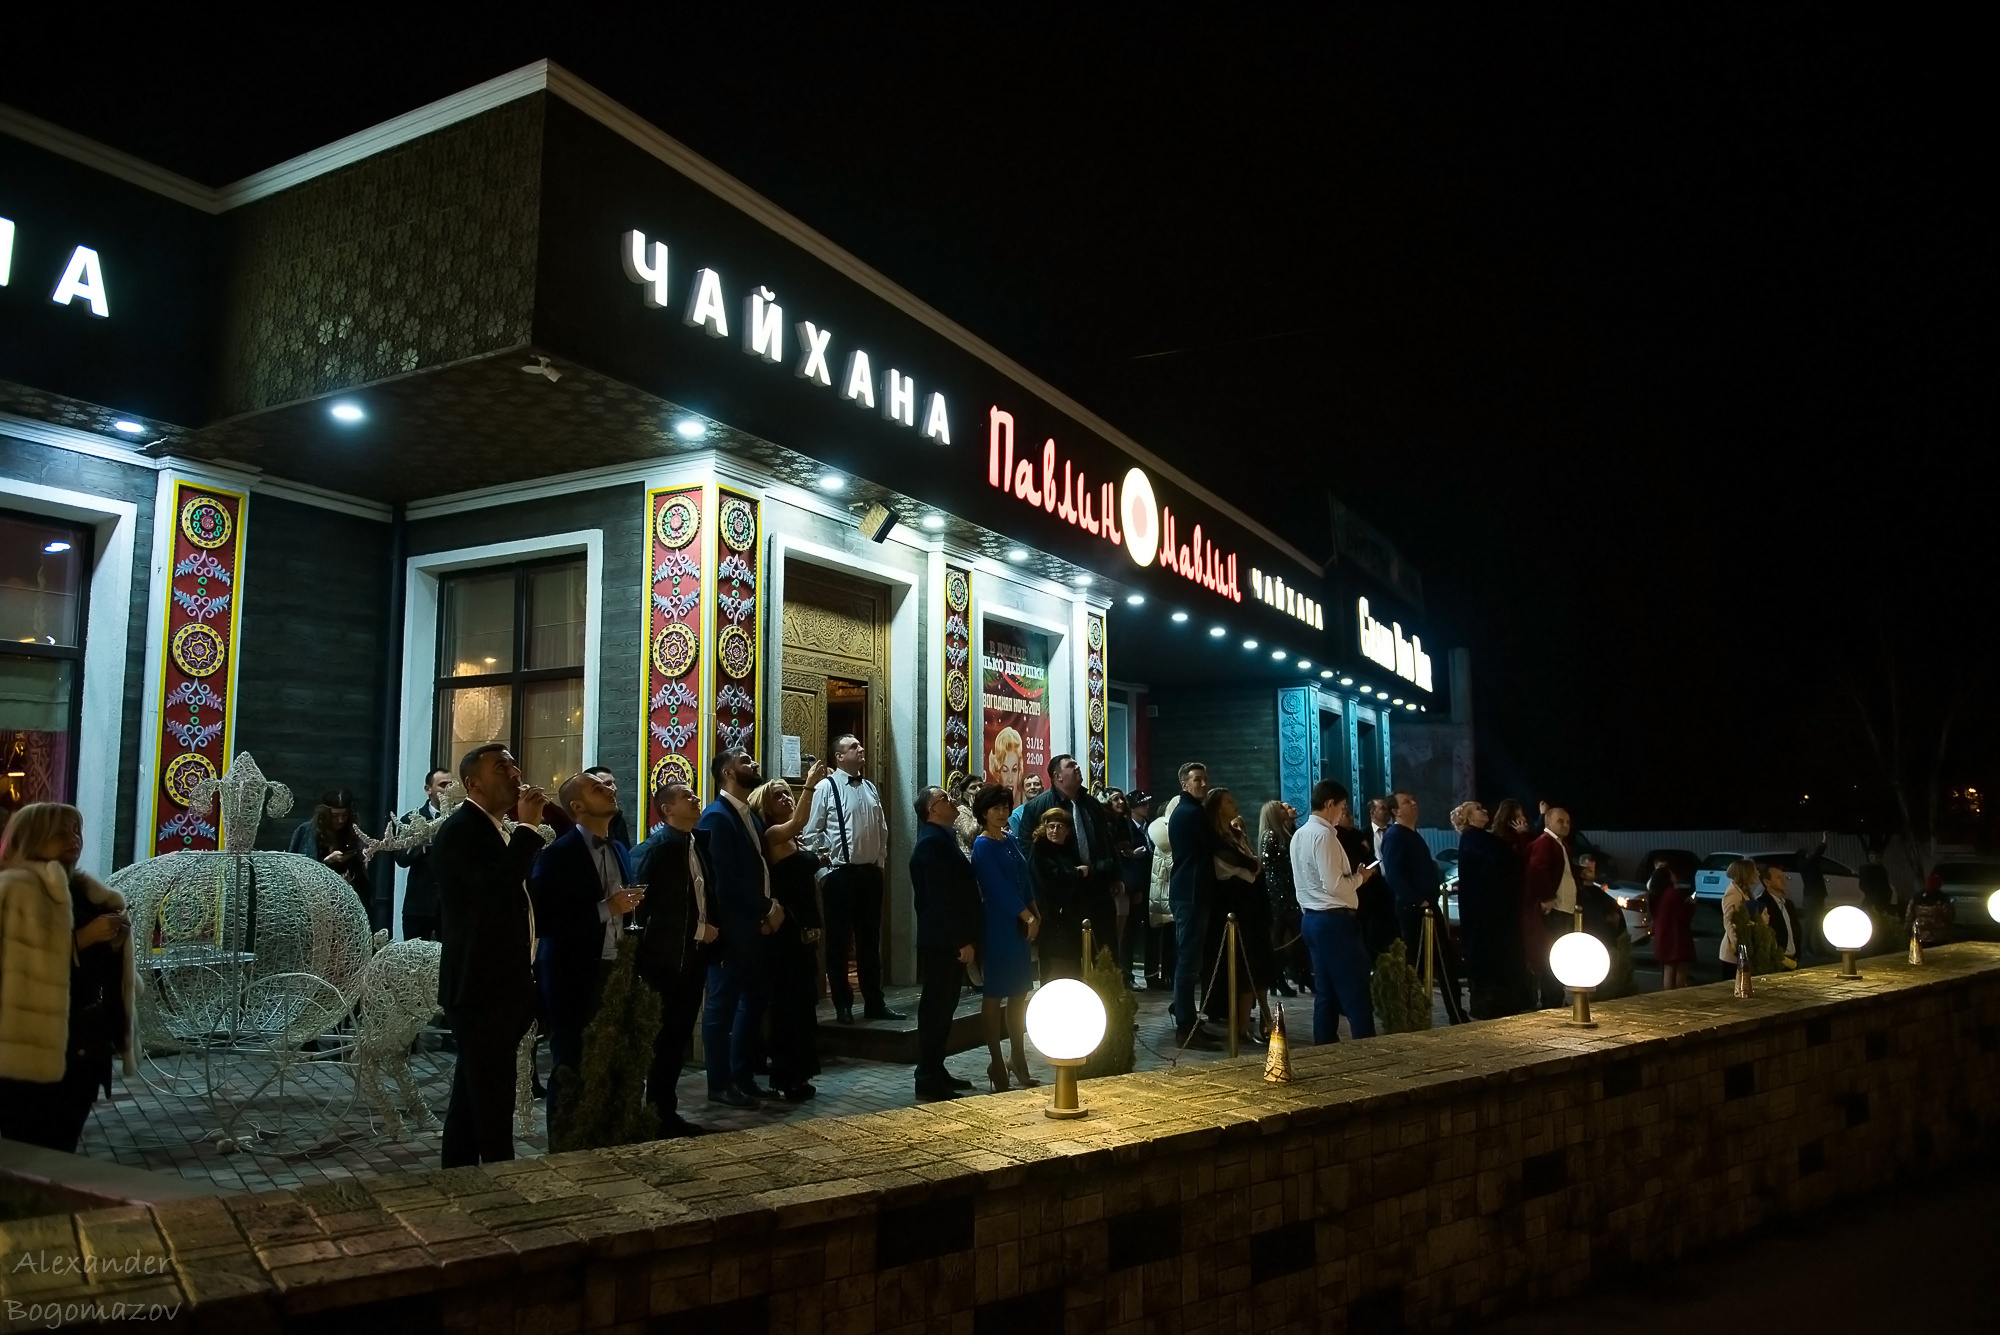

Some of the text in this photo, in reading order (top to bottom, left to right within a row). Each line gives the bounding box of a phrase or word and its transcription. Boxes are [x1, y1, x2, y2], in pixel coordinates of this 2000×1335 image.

[622, 228, 1324, 631] ЧАЙХАНА Павлин Мавлин ЧАЙХАНА
[989, 640, 1027, 661] В ДЖАЗЕ
[1004, 660, 1045, 681] ДЕВУШКИ
[1026, 736, 1044, 751] 31/12
[1026, 752, 1044, 766] 22:00
